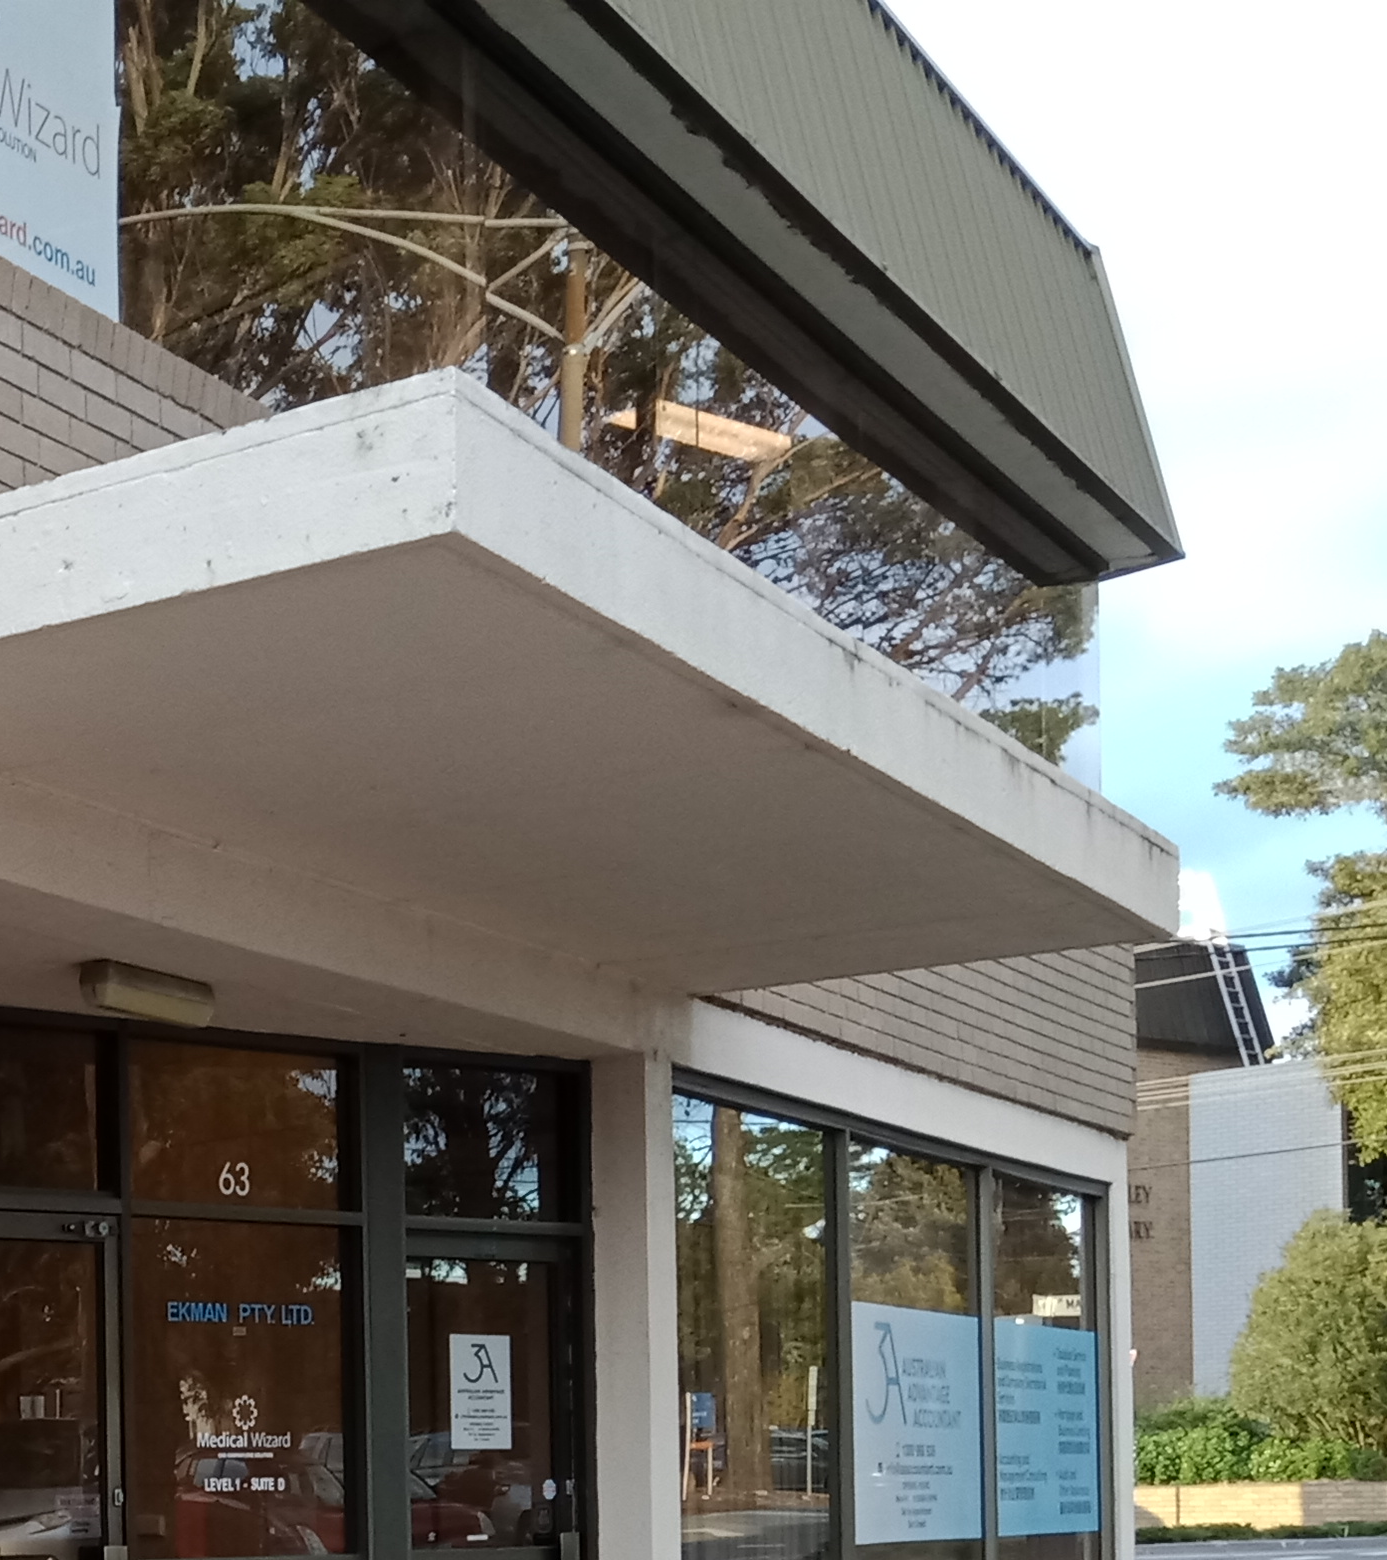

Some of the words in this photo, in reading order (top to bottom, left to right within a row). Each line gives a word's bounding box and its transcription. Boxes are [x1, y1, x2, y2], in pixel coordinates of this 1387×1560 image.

[218, 1161, 251, 1197] 63
[167, 1301, 227, 1323] EKMAN
[196, 1431, 247, 1448] Medical
[250, 1431, 291, 1448] Wizard
[204, 1477, 235, 1492] LEVEL
[235, 1477, 241, 1491] 1
[250, 1477, 275, 1491] SUITE
